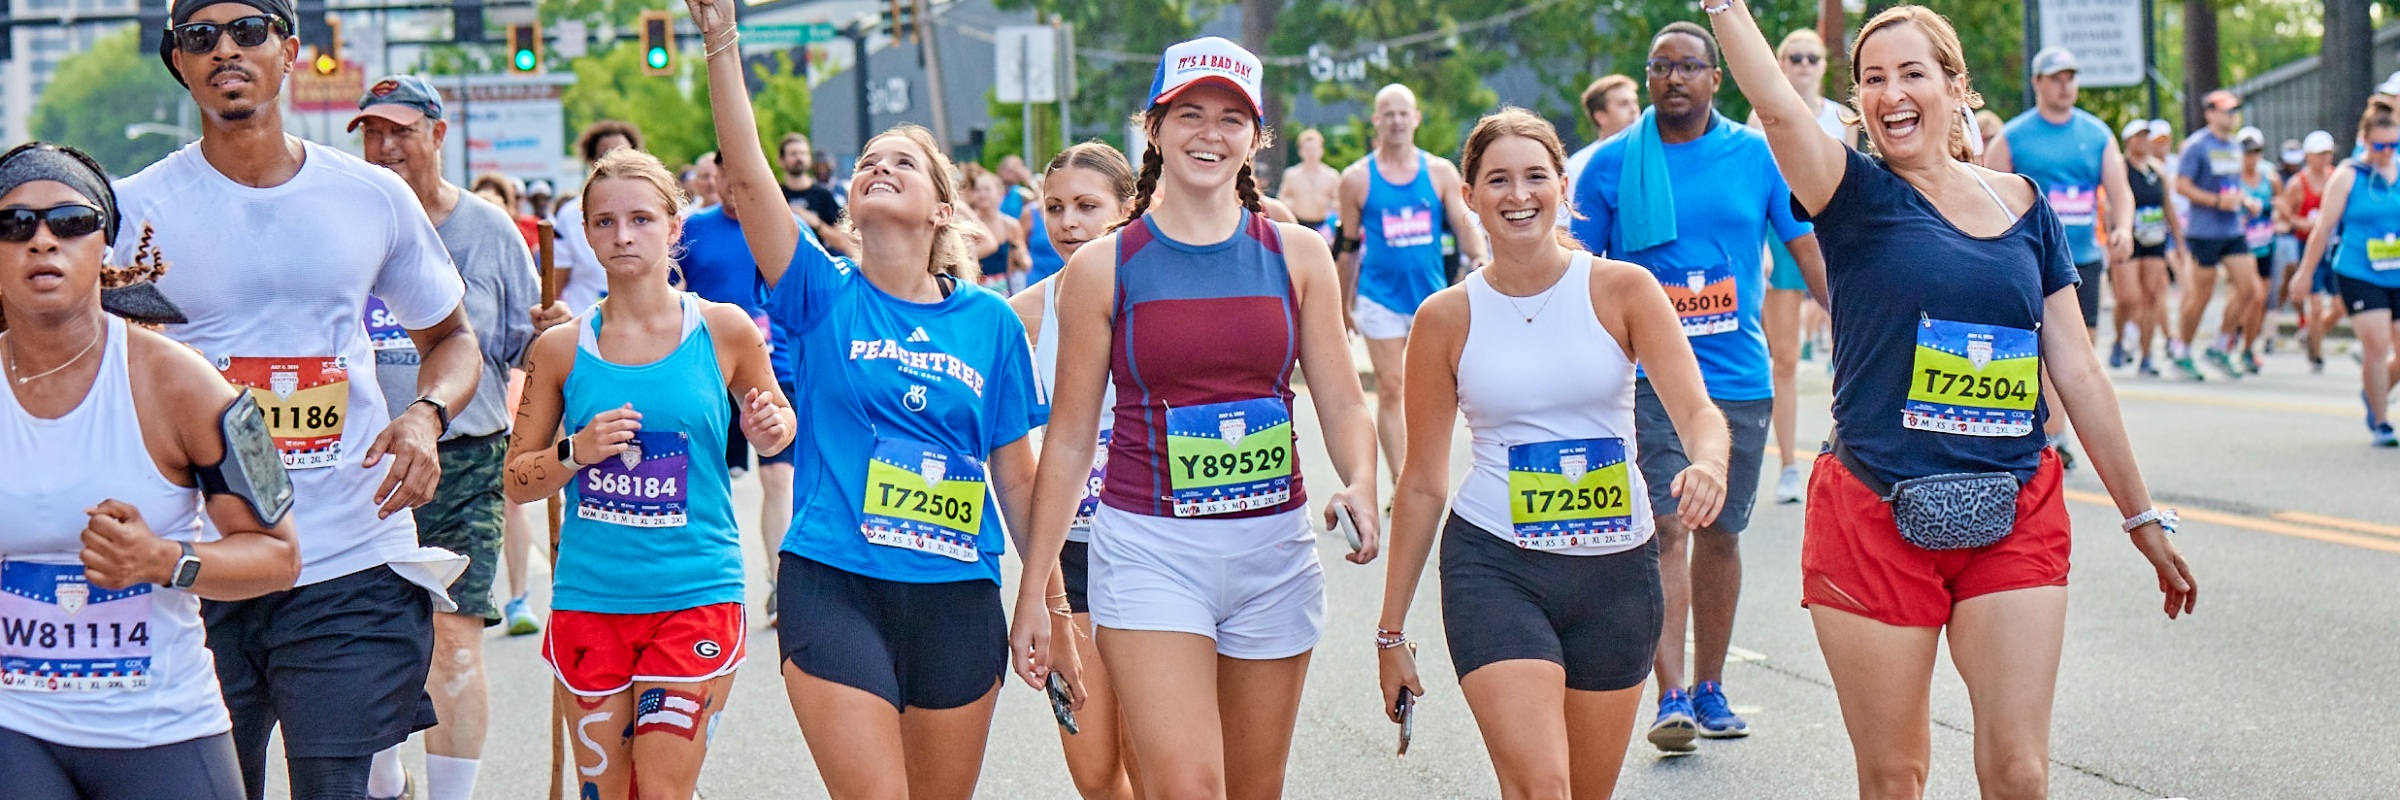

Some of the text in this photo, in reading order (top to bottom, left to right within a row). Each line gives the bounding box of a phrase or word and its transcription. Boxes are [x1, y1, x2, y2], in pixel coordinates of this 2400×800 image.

[1178, 56, 1197, 69] IT'S
[1200, 54, 1206, 66] A
[1211, 55, 1232, 69] BAD
[1235, 61, 1252, 78] DAY
[1670, 293, 1732, 312] 65016
[372, 309, 398, 327] S6
[850, 339, 985, 398] PEACHTREE
[1925, 368, 2027, 401] T72504
[1178, 446, 1285, 480] Y89529
[588, 468, 678, 498] S68184
[878, 482, 972, 524] T72503
[1521, 486, 1623, 514] T72502
[2, 617, 149, 649] W81114
[694, 640, 721, 659] G
